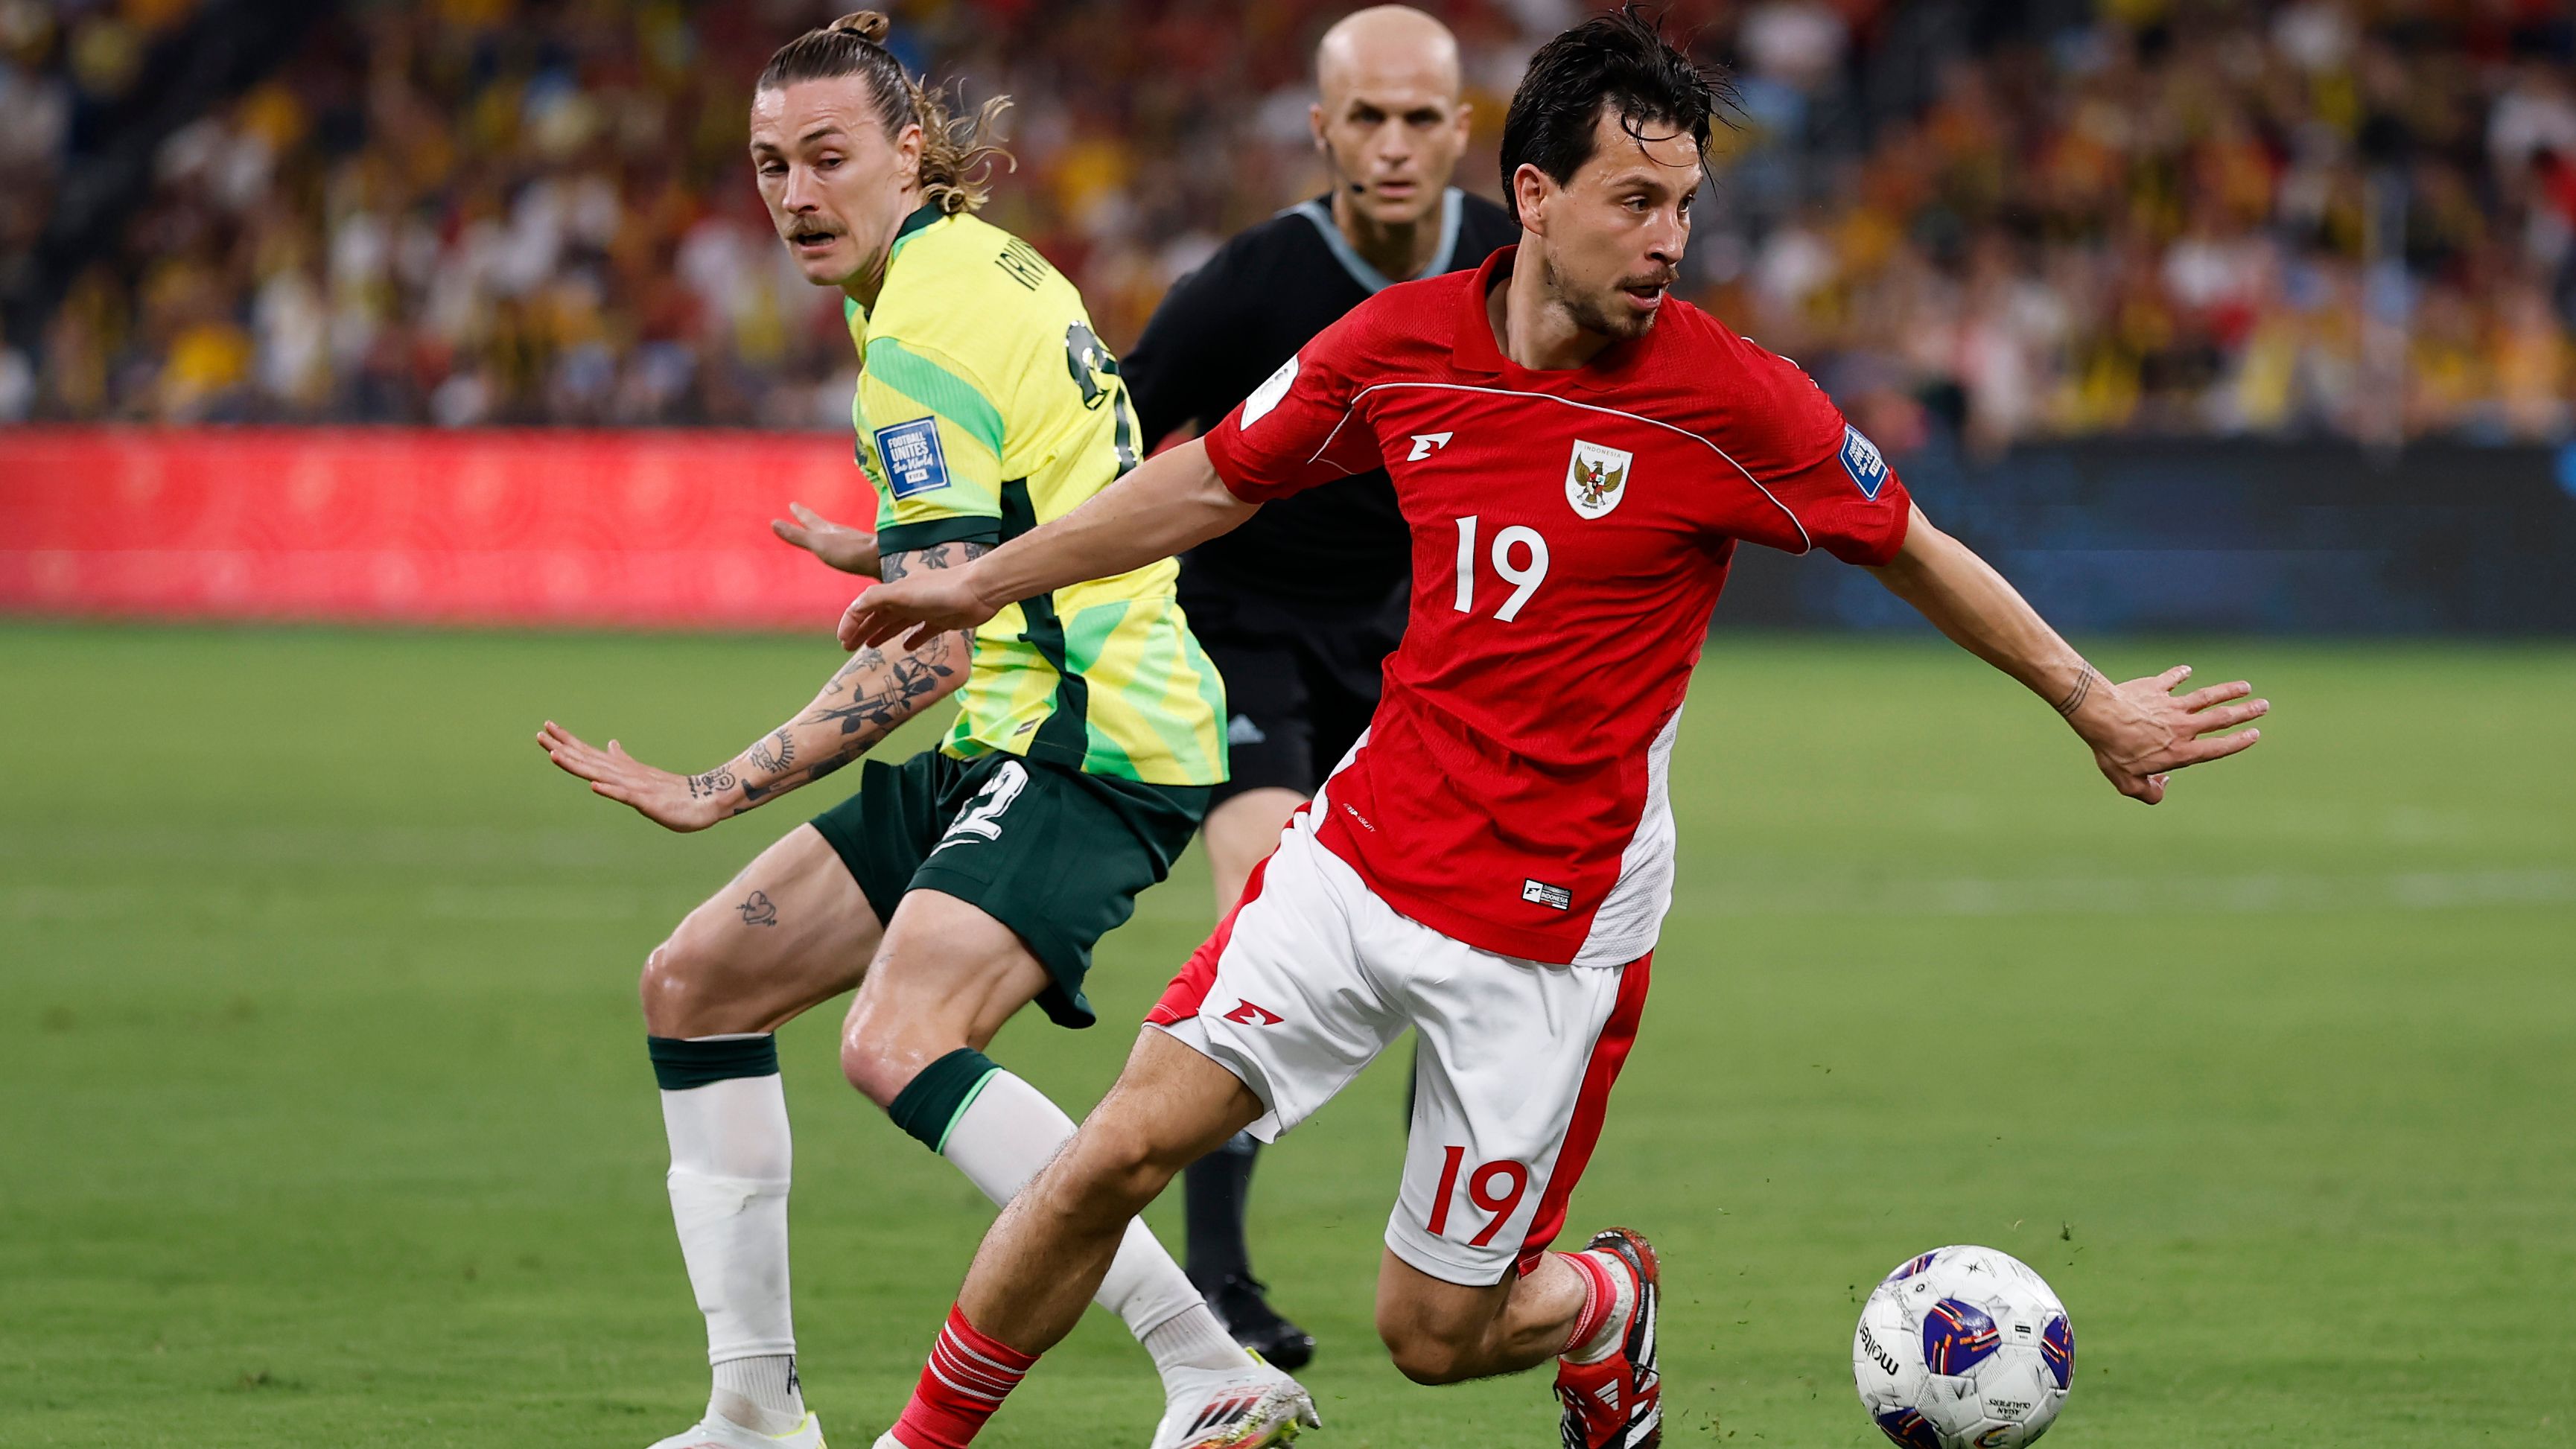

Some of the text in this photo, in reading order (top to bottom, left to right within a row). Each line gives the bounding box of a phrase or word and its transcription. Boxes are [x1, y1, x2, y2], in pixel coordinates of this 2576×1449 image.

[887, 431, 926, 449] FOOTBALL
[890, 441, 929, 462] UNITES
[1584, 445, 1621, 458] INDONESIA
[892, 453, 934, 475] the World
[1453, 515, 1550, 623] 19
[1541, 892, 1568, 904] INDONESIA
[1425, 1145, 1529, 1247] 19
[1860, 1316, 1899, 1376] molten
